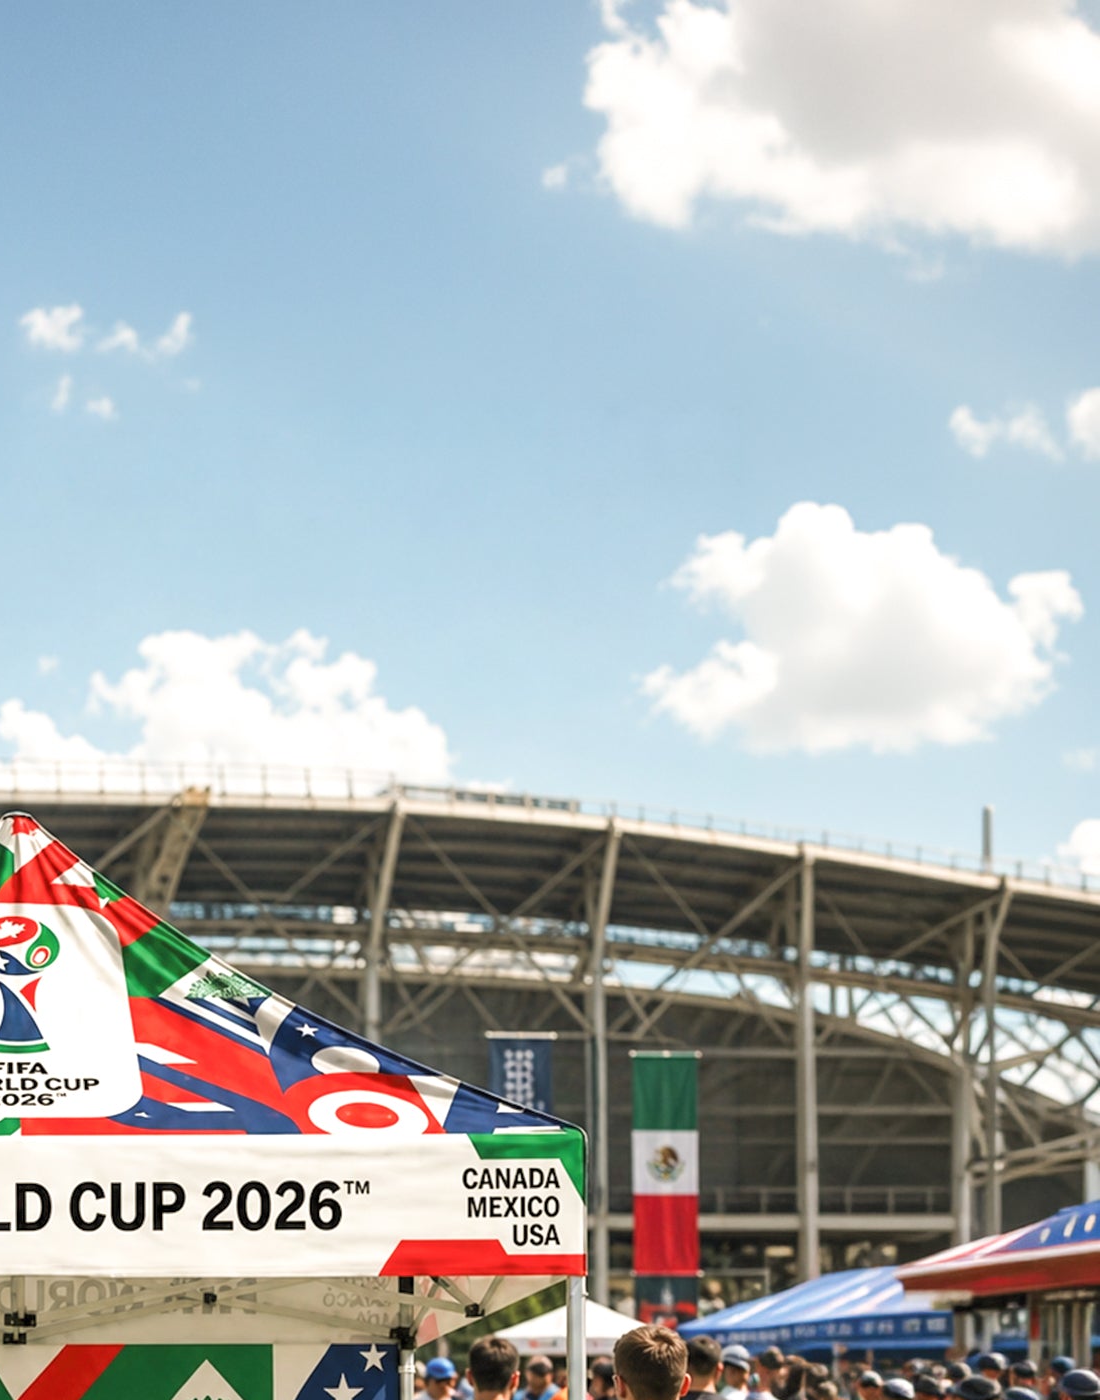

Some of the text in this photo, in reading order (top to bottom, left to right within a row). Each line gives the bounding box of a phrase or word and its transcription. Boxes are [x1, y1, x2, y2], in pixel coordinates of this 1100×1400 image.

[44, 1077, 100, 1091] CUP
[462, 1167, 561, 1190] CANADA
[69, 1181, 186, 1232] CUP
[467, 1195, 560, 1218] MEXICO
[512, 1223, 561, 1247] USA
